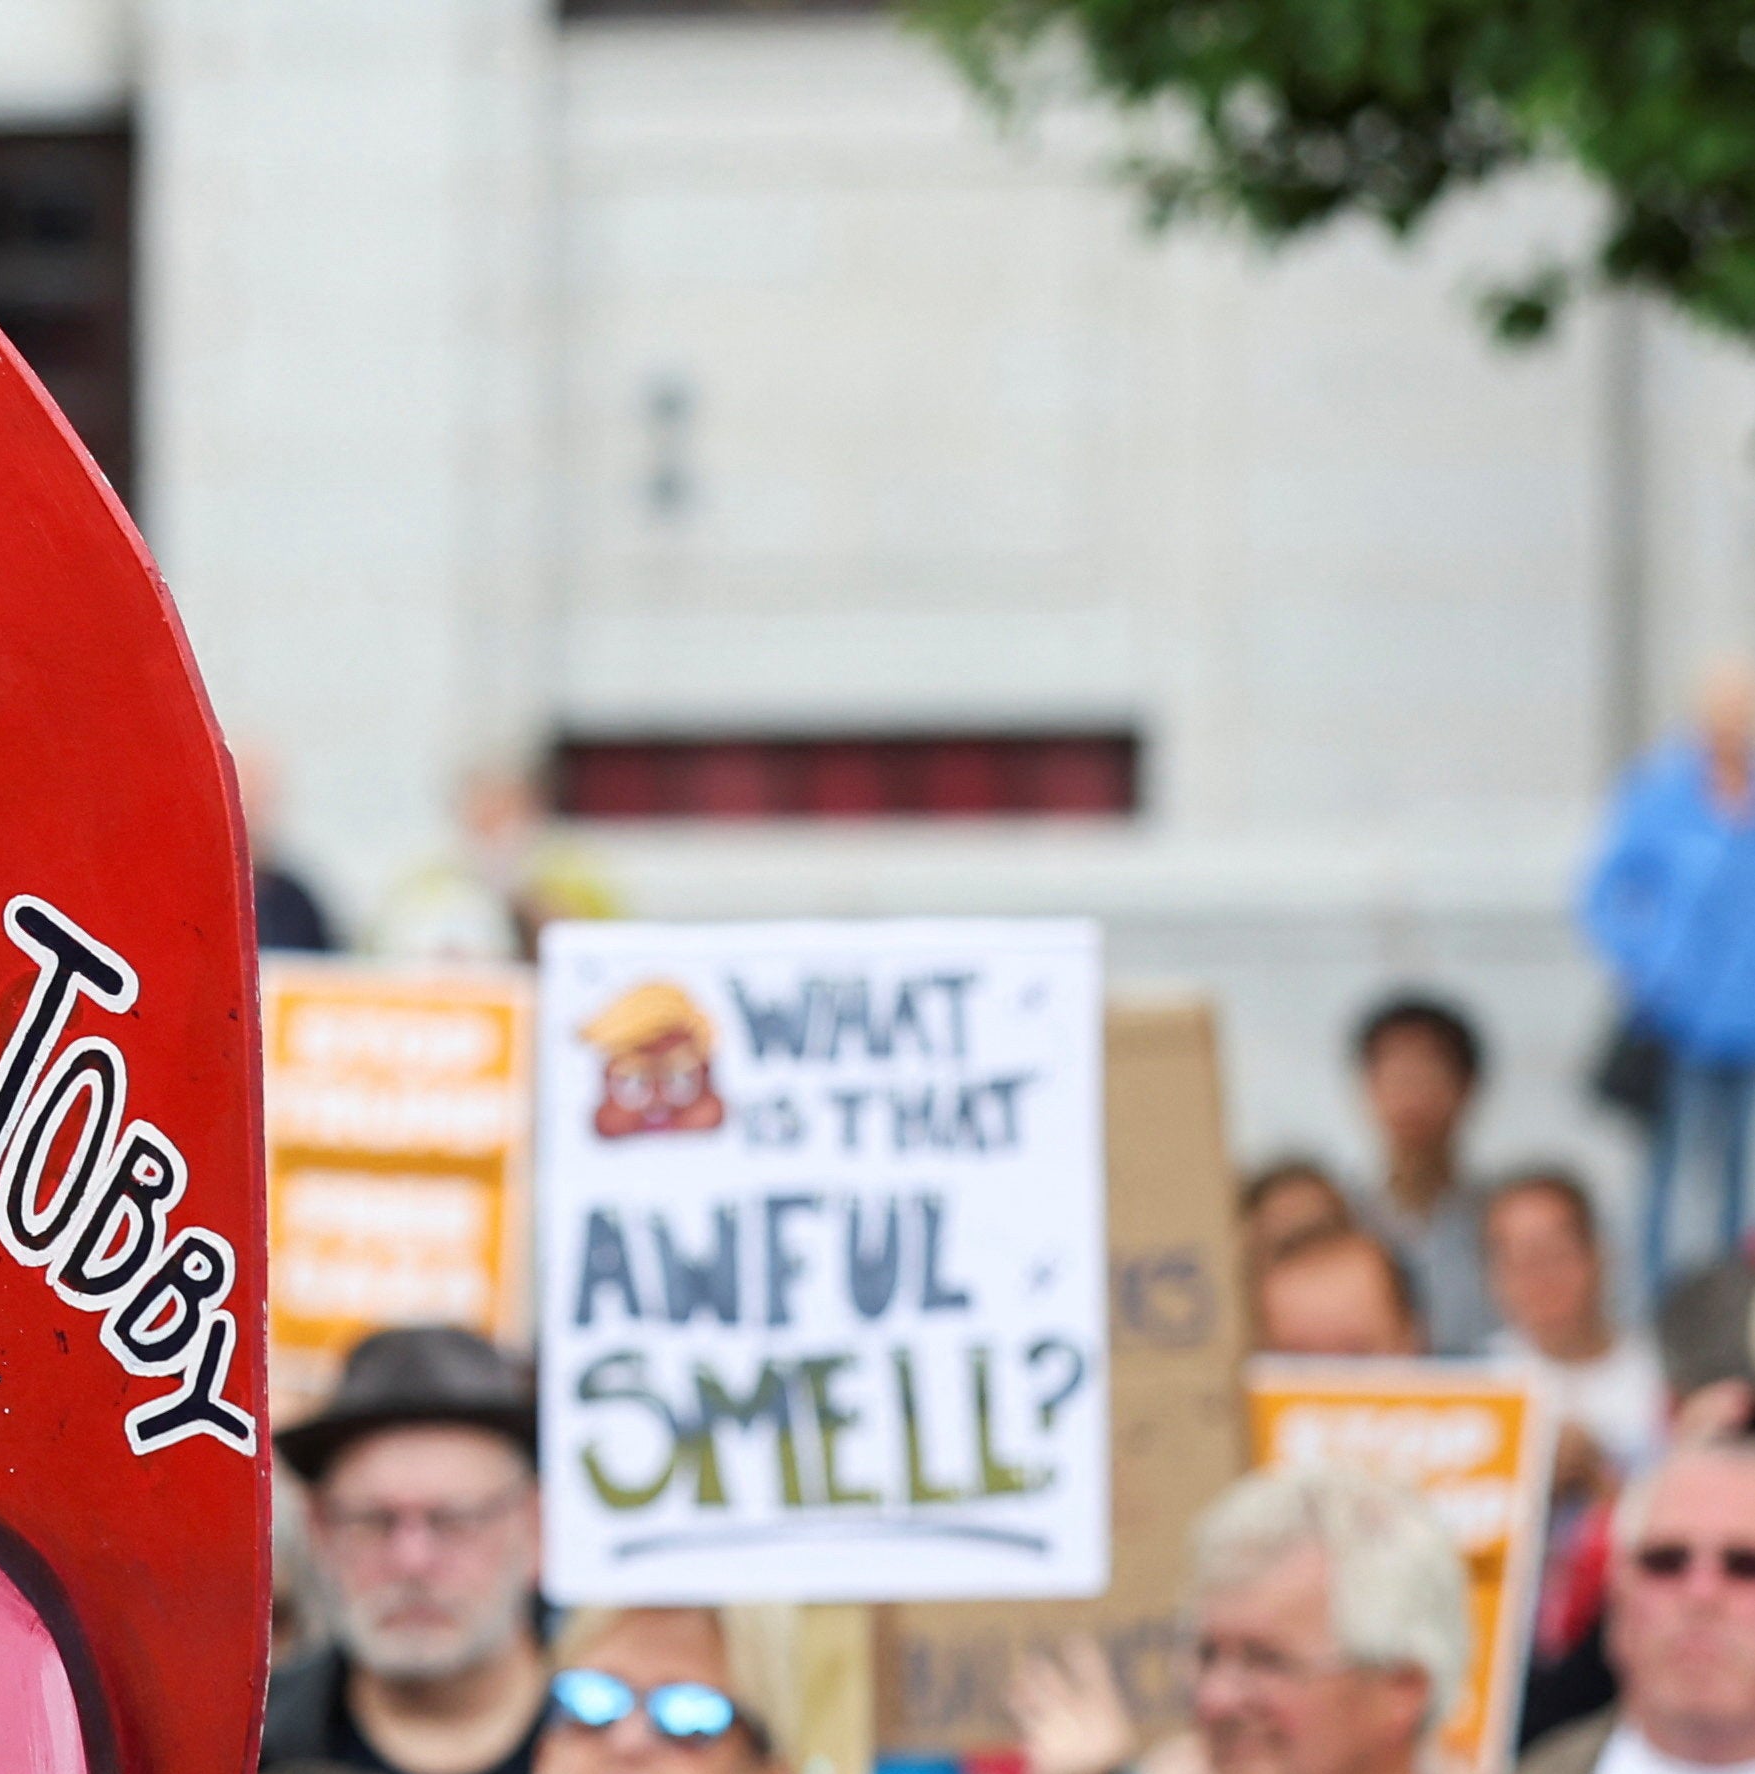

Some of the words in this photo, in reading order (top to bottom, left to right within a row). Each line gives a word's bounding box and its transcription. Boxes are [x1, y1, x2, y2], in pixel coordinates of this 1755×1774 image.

[730, 972, 976, 1059] WHAT
[745, 1094, 802, 1151] IS
[834, 1070, 1037, 1153] THAT
[574, 1194, 971, 1328] AWFUL
[576, 1337, 1084, 1508] SMELL?
